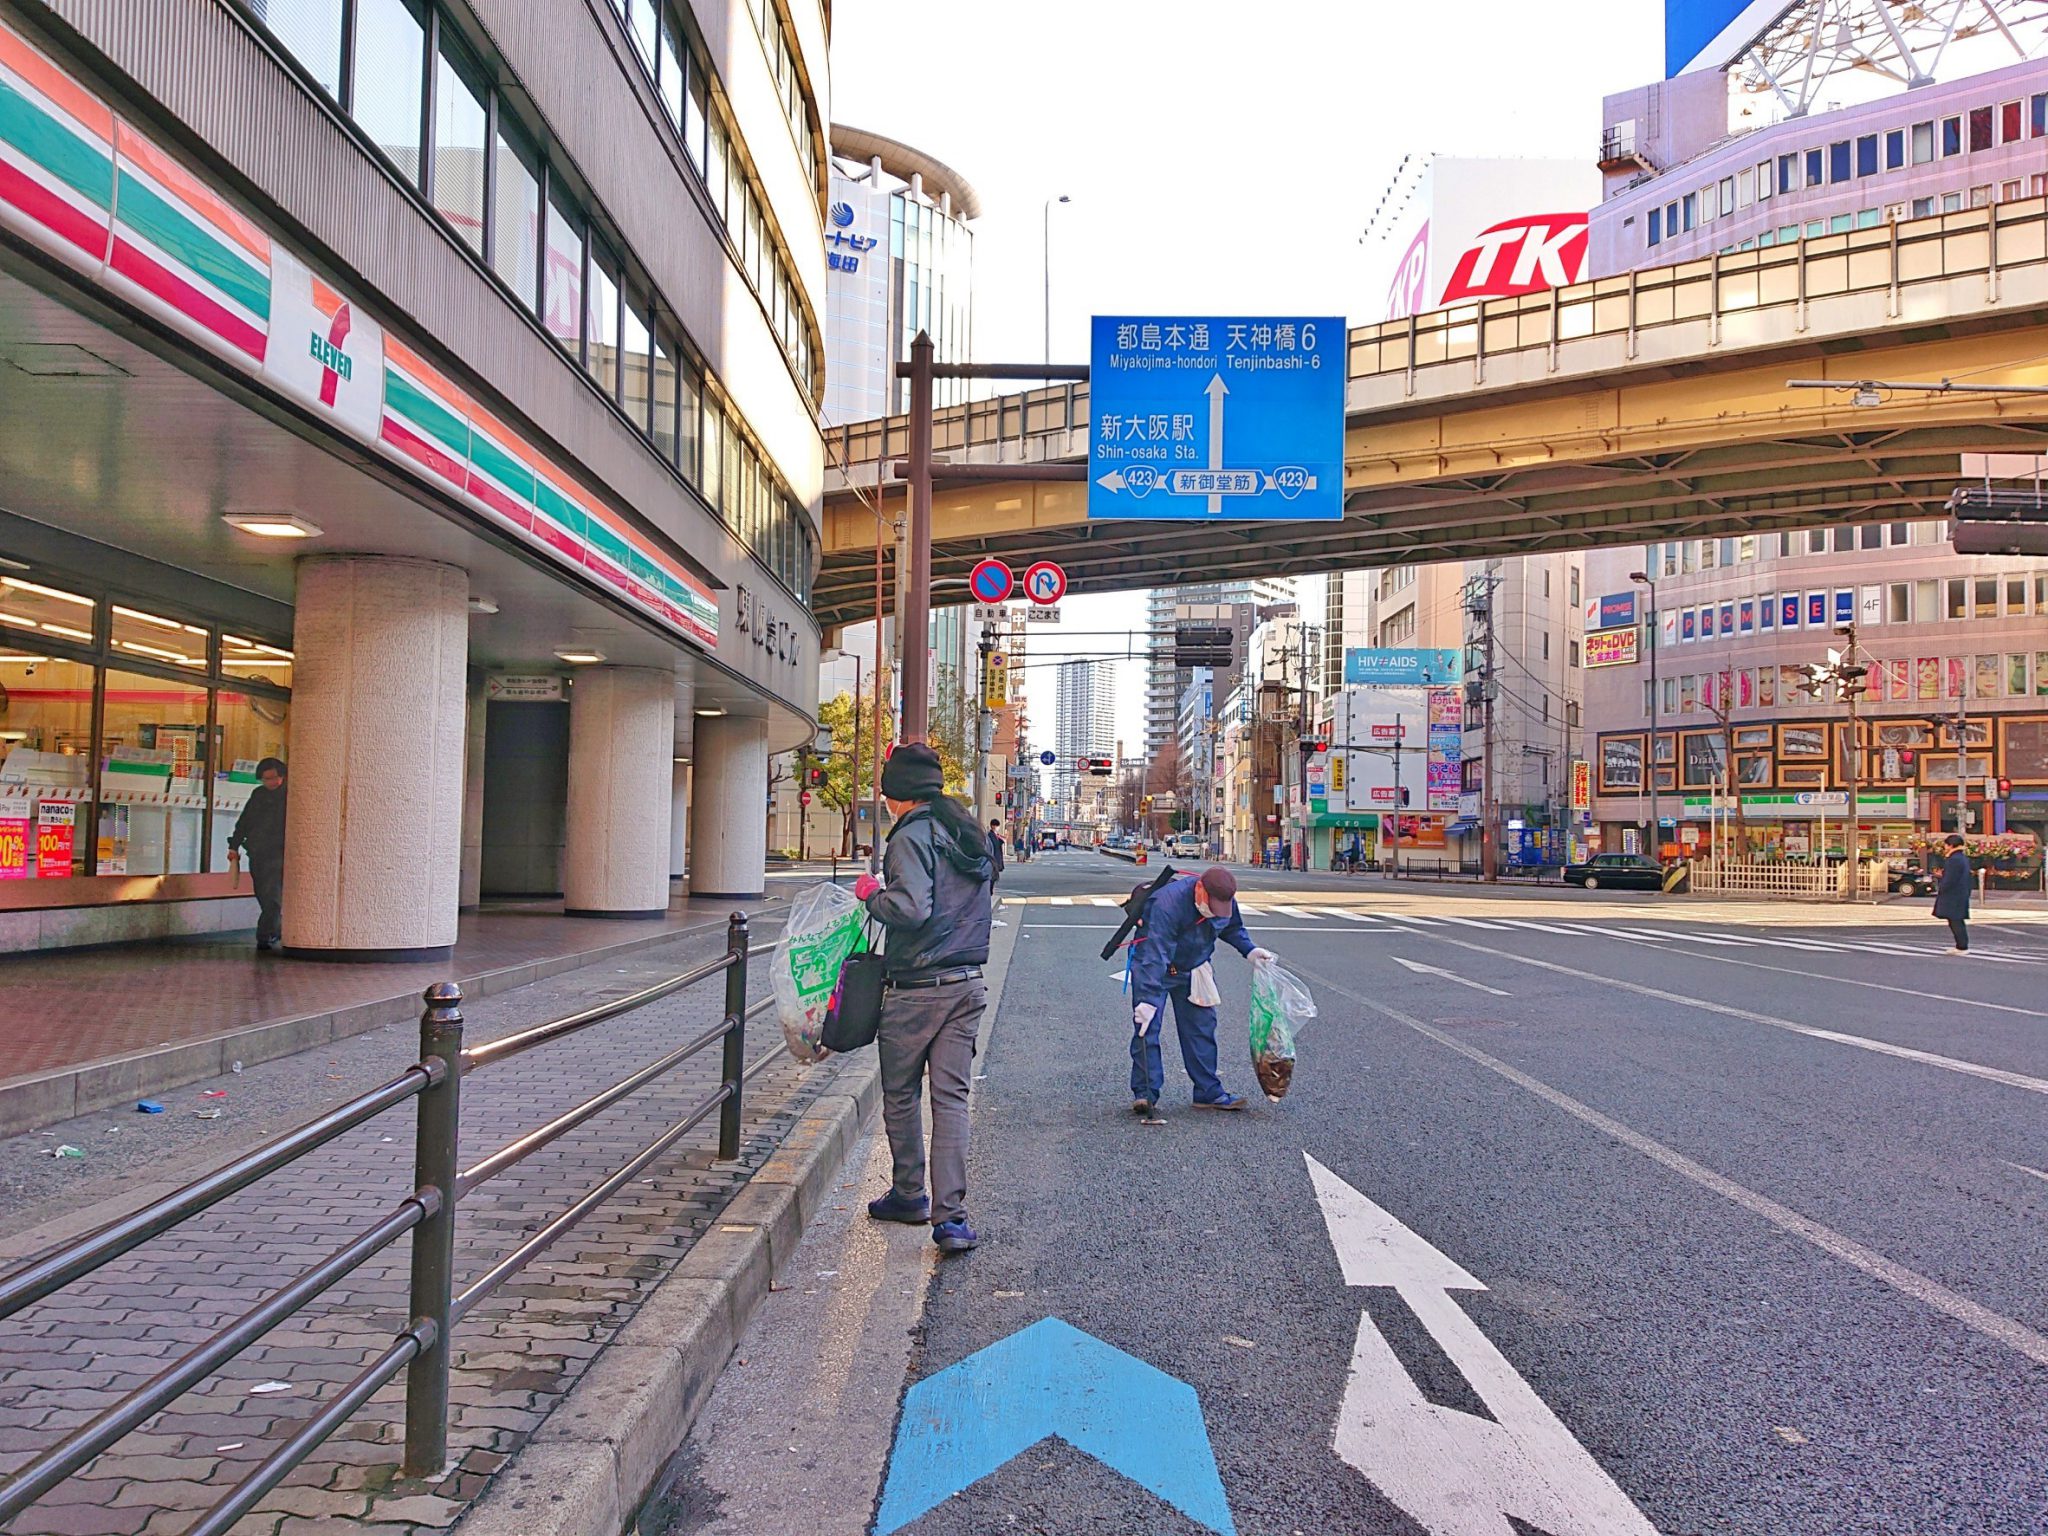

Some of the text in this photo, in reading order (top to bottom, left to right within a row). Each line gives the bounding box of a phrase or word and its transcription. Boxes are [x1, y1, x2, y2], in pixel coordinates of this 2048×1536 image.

[1116, 323, 1317, 351] 都島本通 天神橋6
[1109, 354, 1321, 371] Miyakojima-hondori Tenjinbashi-6
[1100, 414, 1195, 441] 新大阪駅
[1096, 444, 1199, 460] Shin-osaka Sta.
[1127, 470, 1153, 487] 423
[1179, 474, 1251, 491] 新御堂筋
[1277, 470, 1304, 487] 423
[975, 608, 1007, 618] 自動車
[1863, 599, 1880, 611] 4F
[1028, 610, 1060, 620] ここまで
[1685, 602, 1822, 632] PROMISE
